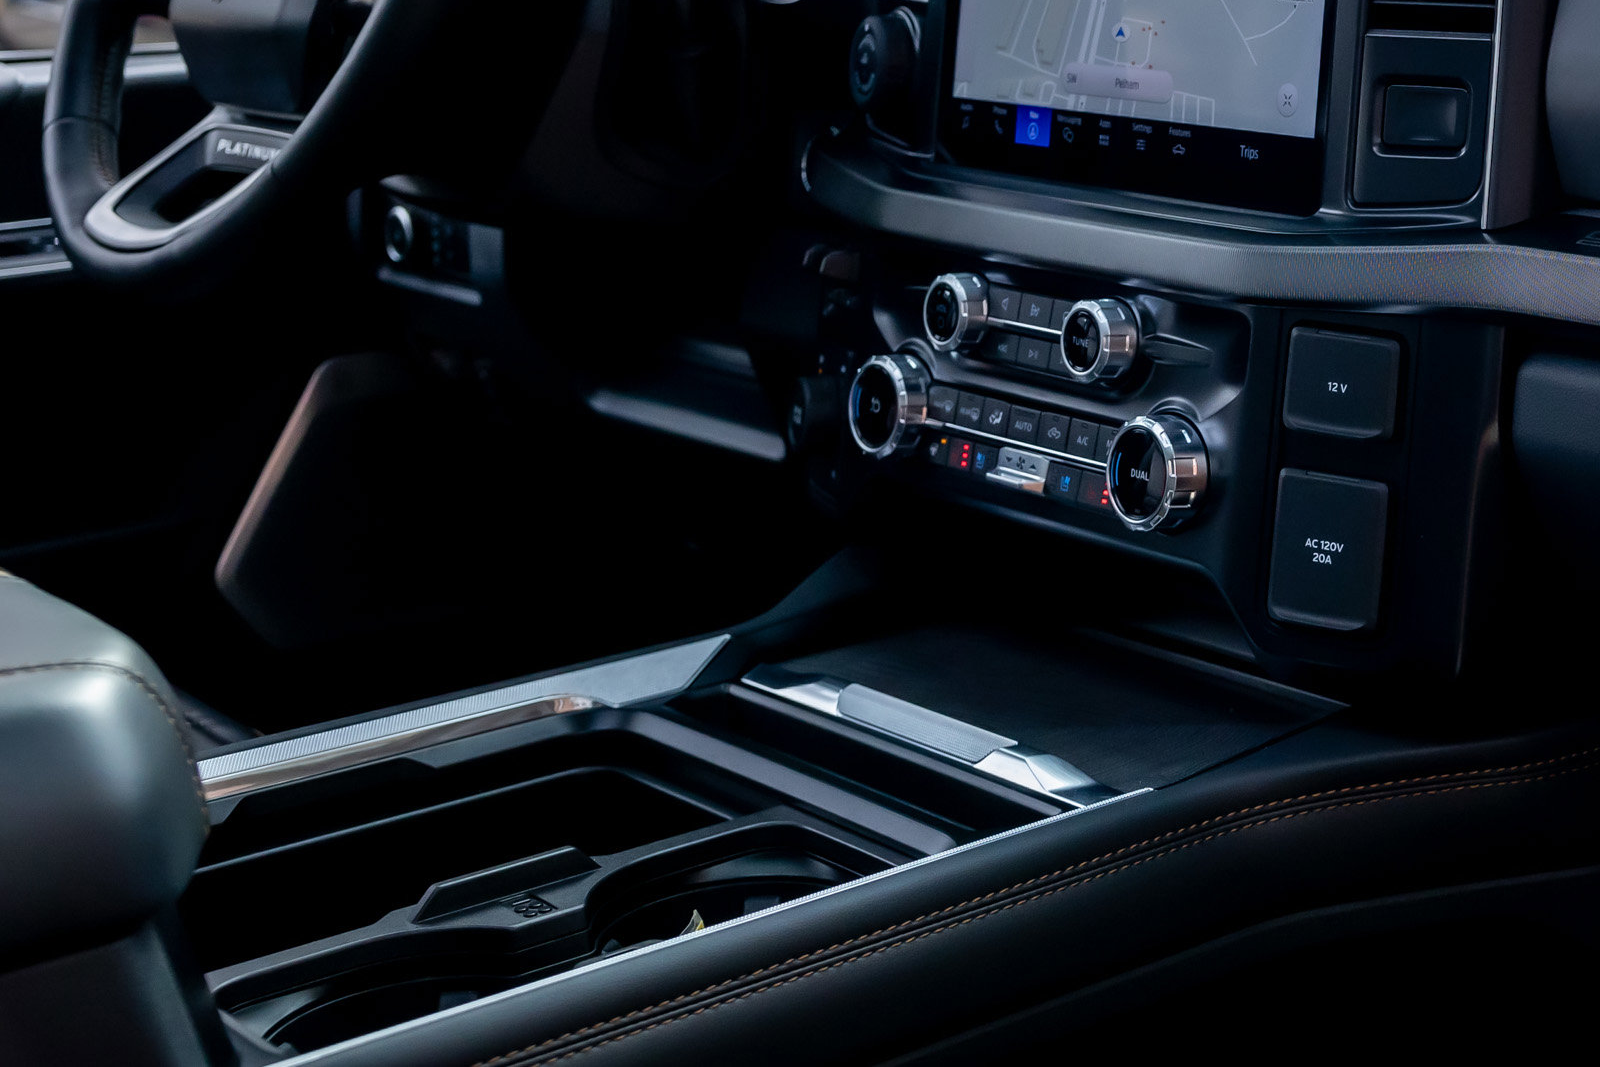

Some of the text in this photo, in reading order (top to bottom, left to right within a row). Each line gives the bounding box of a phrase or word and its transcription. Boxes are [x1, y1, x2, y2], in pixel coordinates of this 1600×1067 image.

[1114, 77, 1140, 90] Pelham
[1239, 144, 1260, 161] Trips
[1071, 336, 1090, 348] TUNE
[1327, 381, 1348, 393] 12 V
[1014, 420, 1033, 433] AUTO
[1076, 435, 1089, 447] A/C
[1130, 467, 1150, 482] DUAL
[1305, 537, 1344, 553] AC 120V
[1312, 553, 1332, 564] 20A
